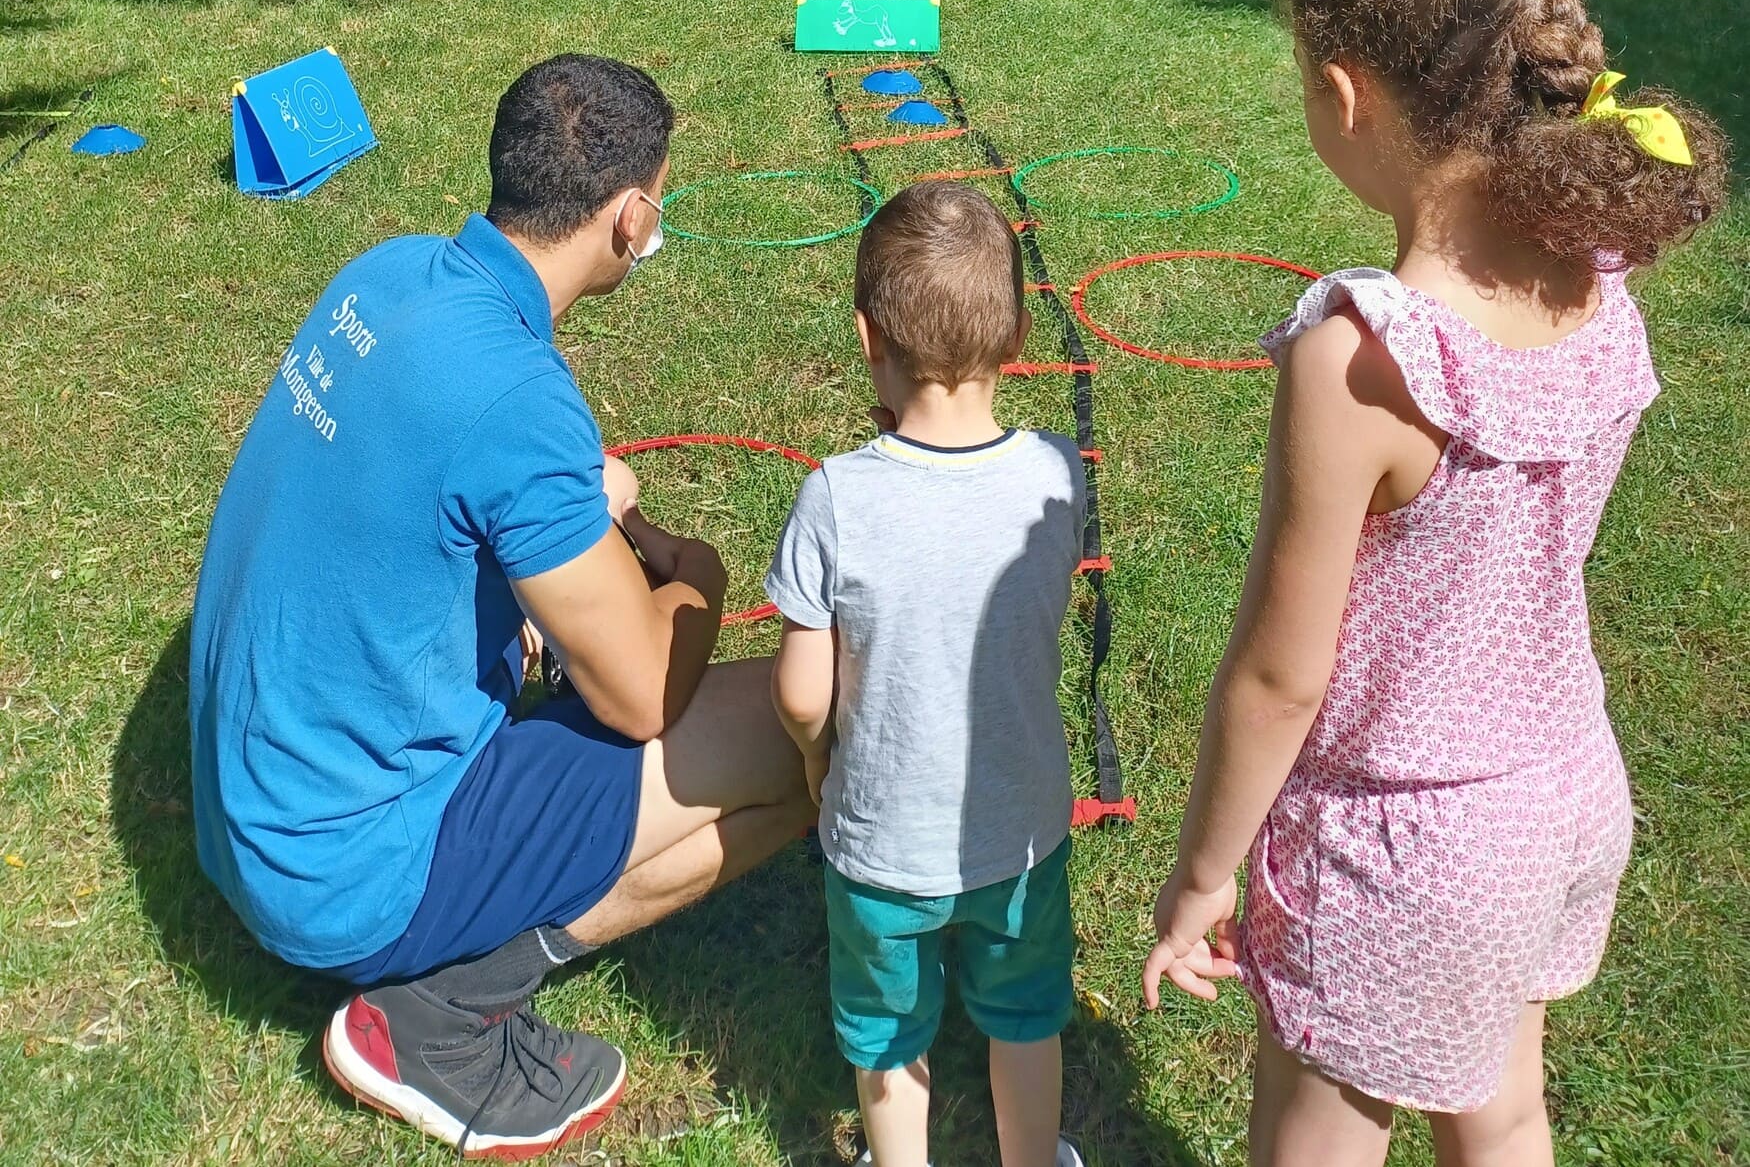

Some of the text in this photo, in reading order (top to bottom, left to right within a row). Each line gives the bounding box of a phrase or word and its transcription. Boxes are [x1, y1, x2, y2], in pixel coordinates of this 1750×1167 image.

[329, 293, 377, 357] Sports
[280, 345, 336, 442] Montgeron
[305, 344, 334, 393] Ville de
